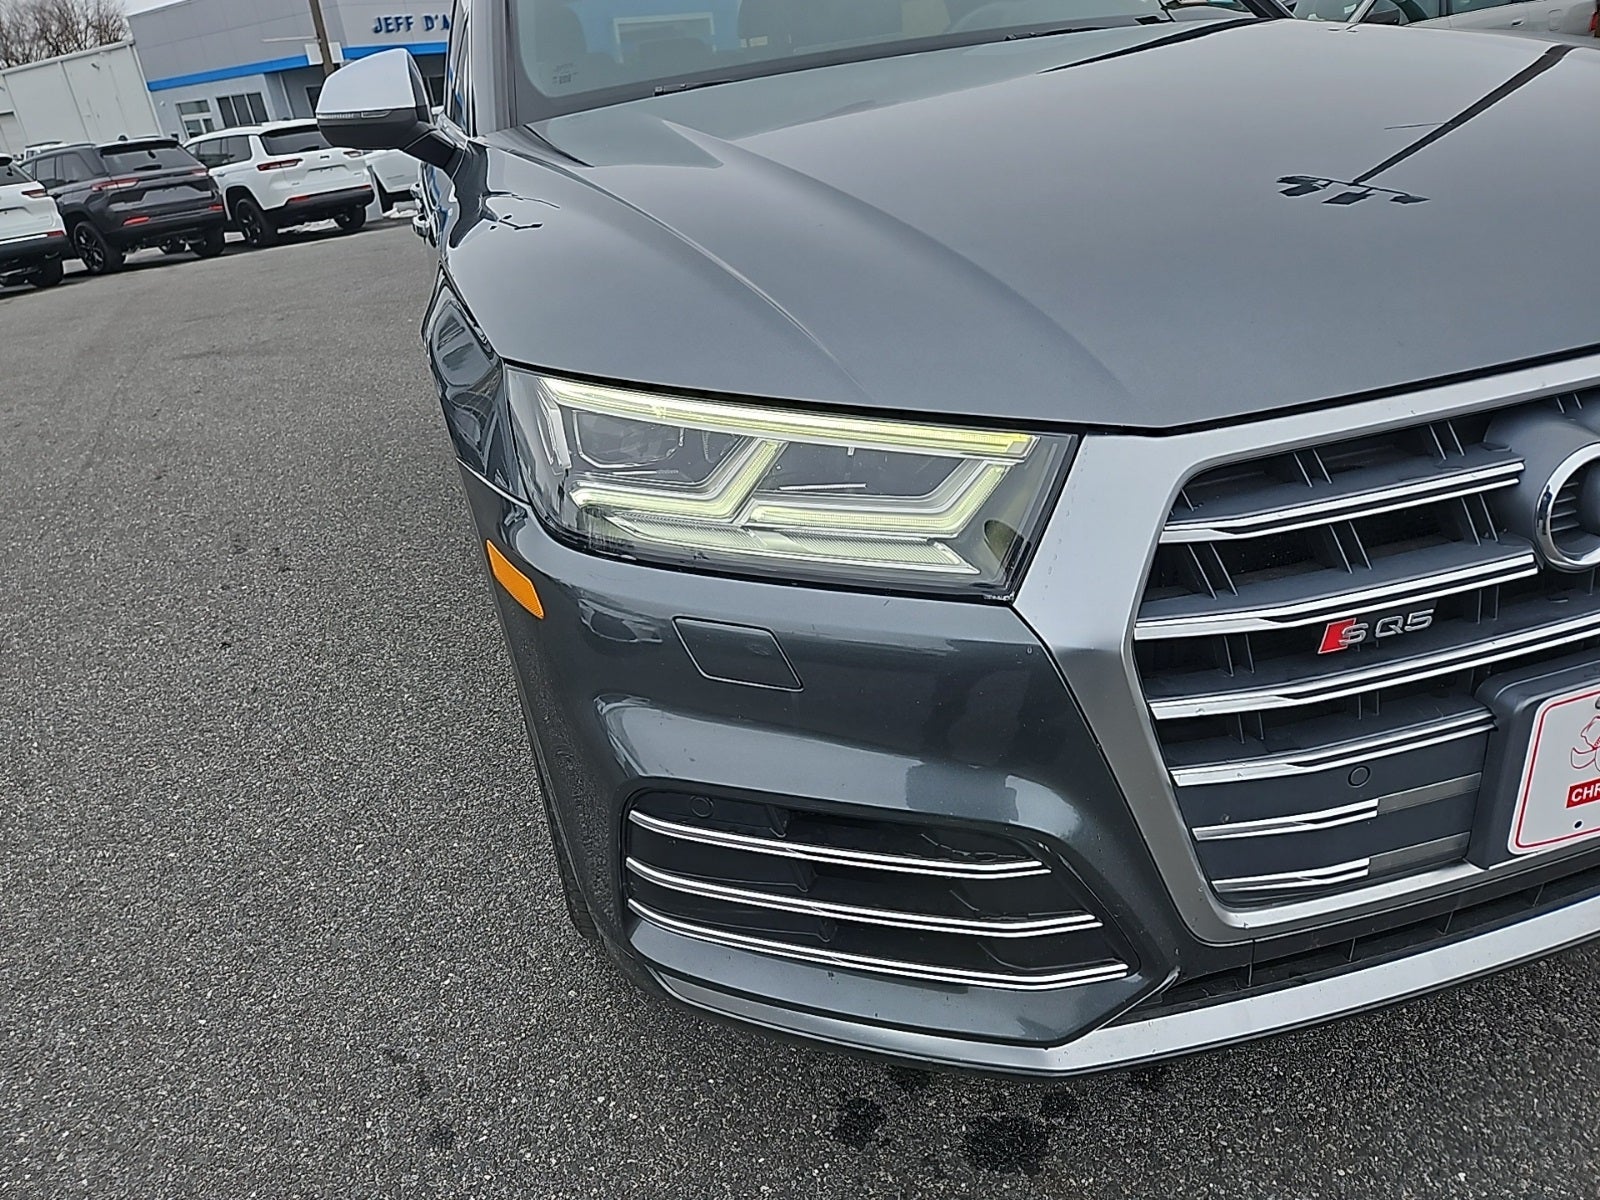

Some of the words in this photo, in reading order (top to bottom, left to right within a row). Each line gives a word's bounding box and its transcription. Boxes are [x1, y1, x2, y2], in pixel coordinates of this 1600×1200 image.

[373, 15, 414, 33] JEFF
[424, 14, 450, 31] D'A
[1339, 609, 1435, 645] SQ5
